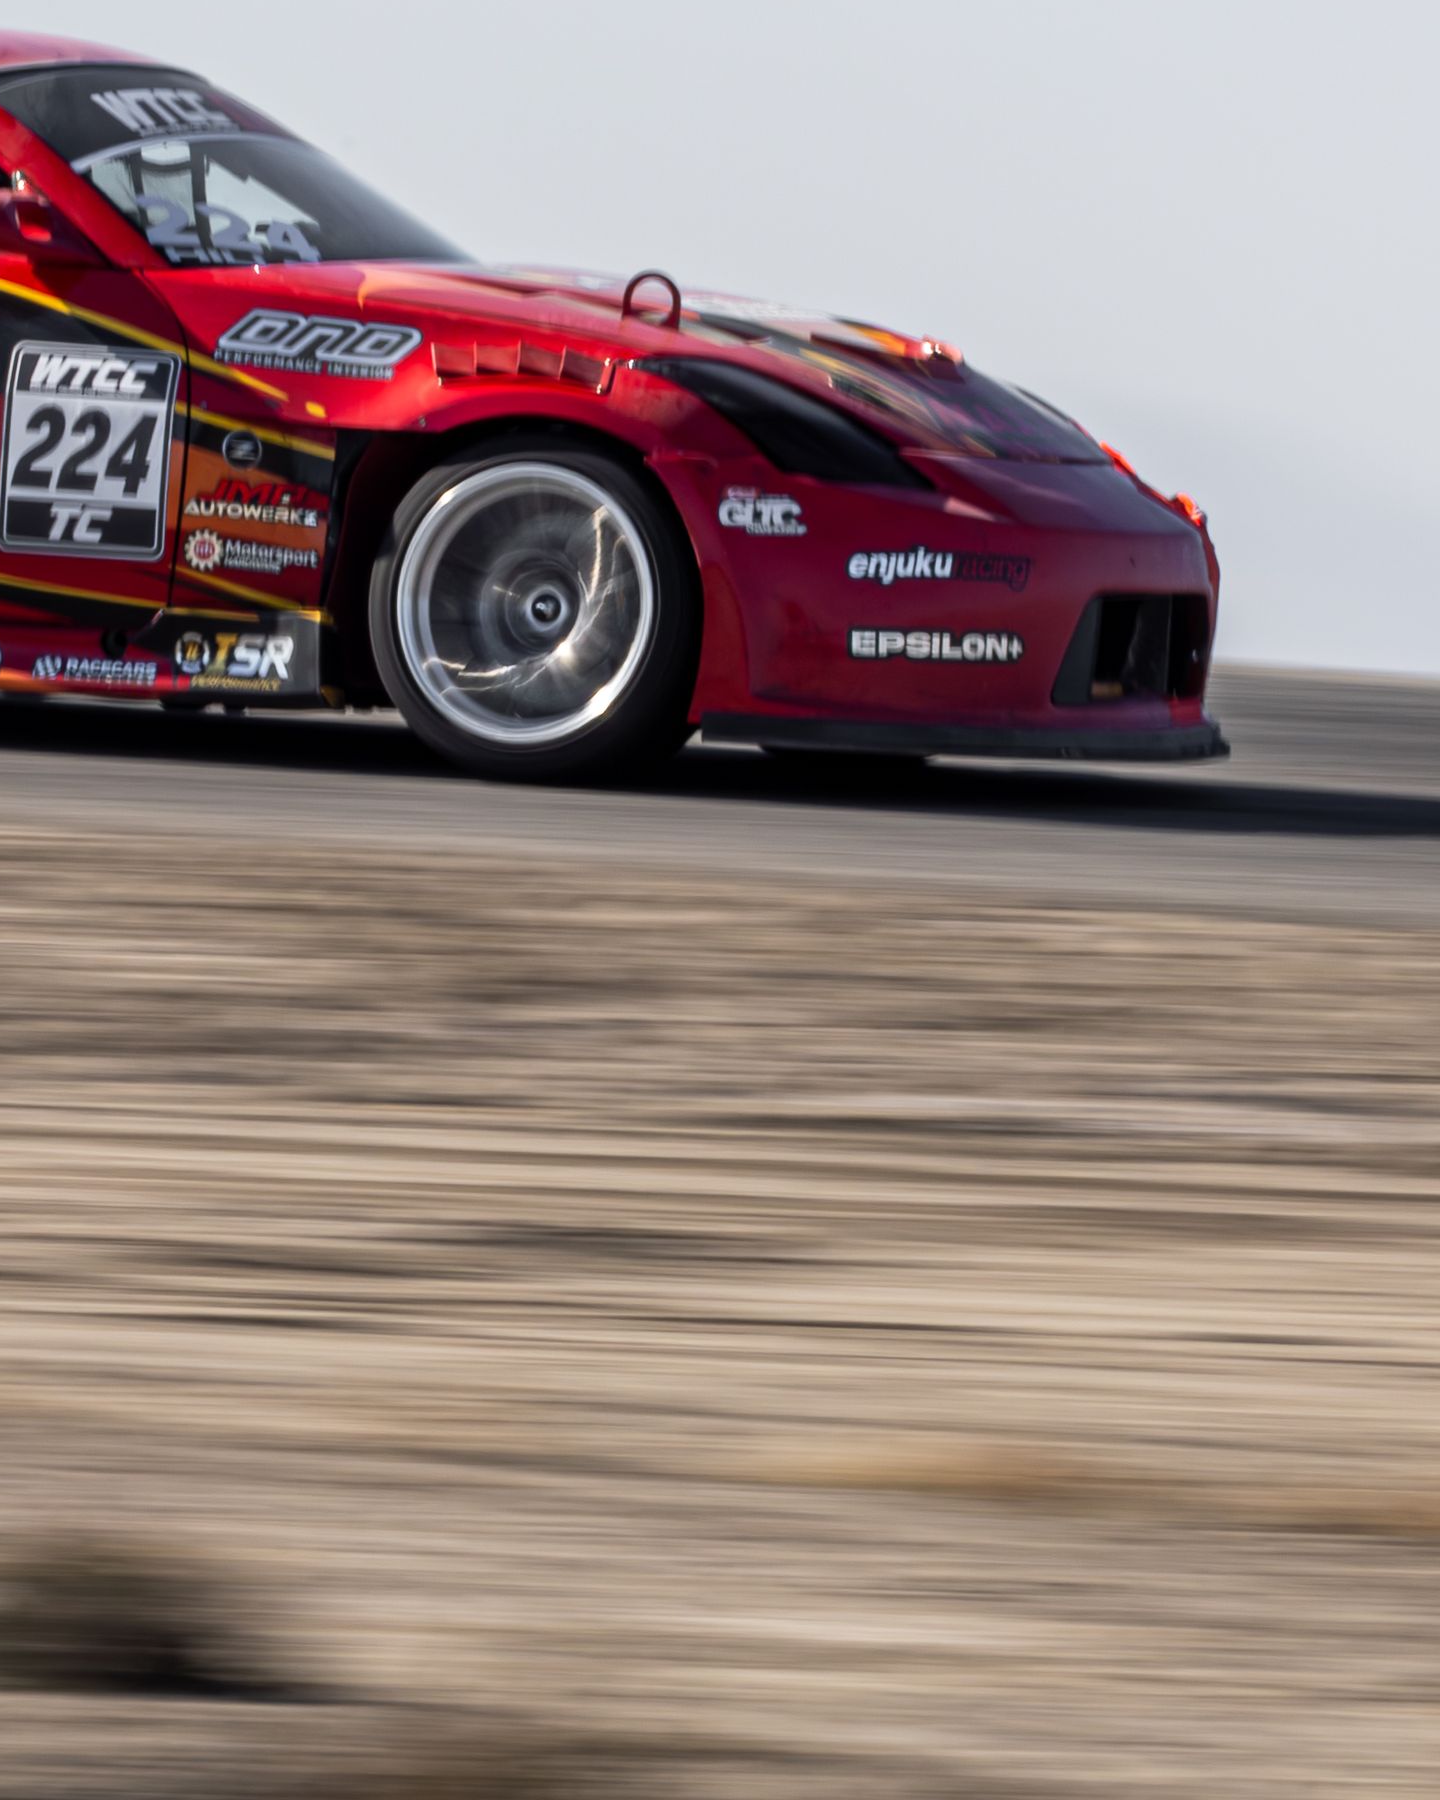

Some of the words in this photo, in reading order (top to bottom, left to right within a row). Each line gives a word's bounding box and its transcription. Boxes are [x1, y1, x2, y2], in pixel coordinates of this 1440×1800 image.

[136, 194, 323, 262] 224
[30, 352, 158, 395] WTCC
[11, 403, 158, 498] 224
[48, 506, 112, 542] TC
[848, 546, 953, 585] enjuku
